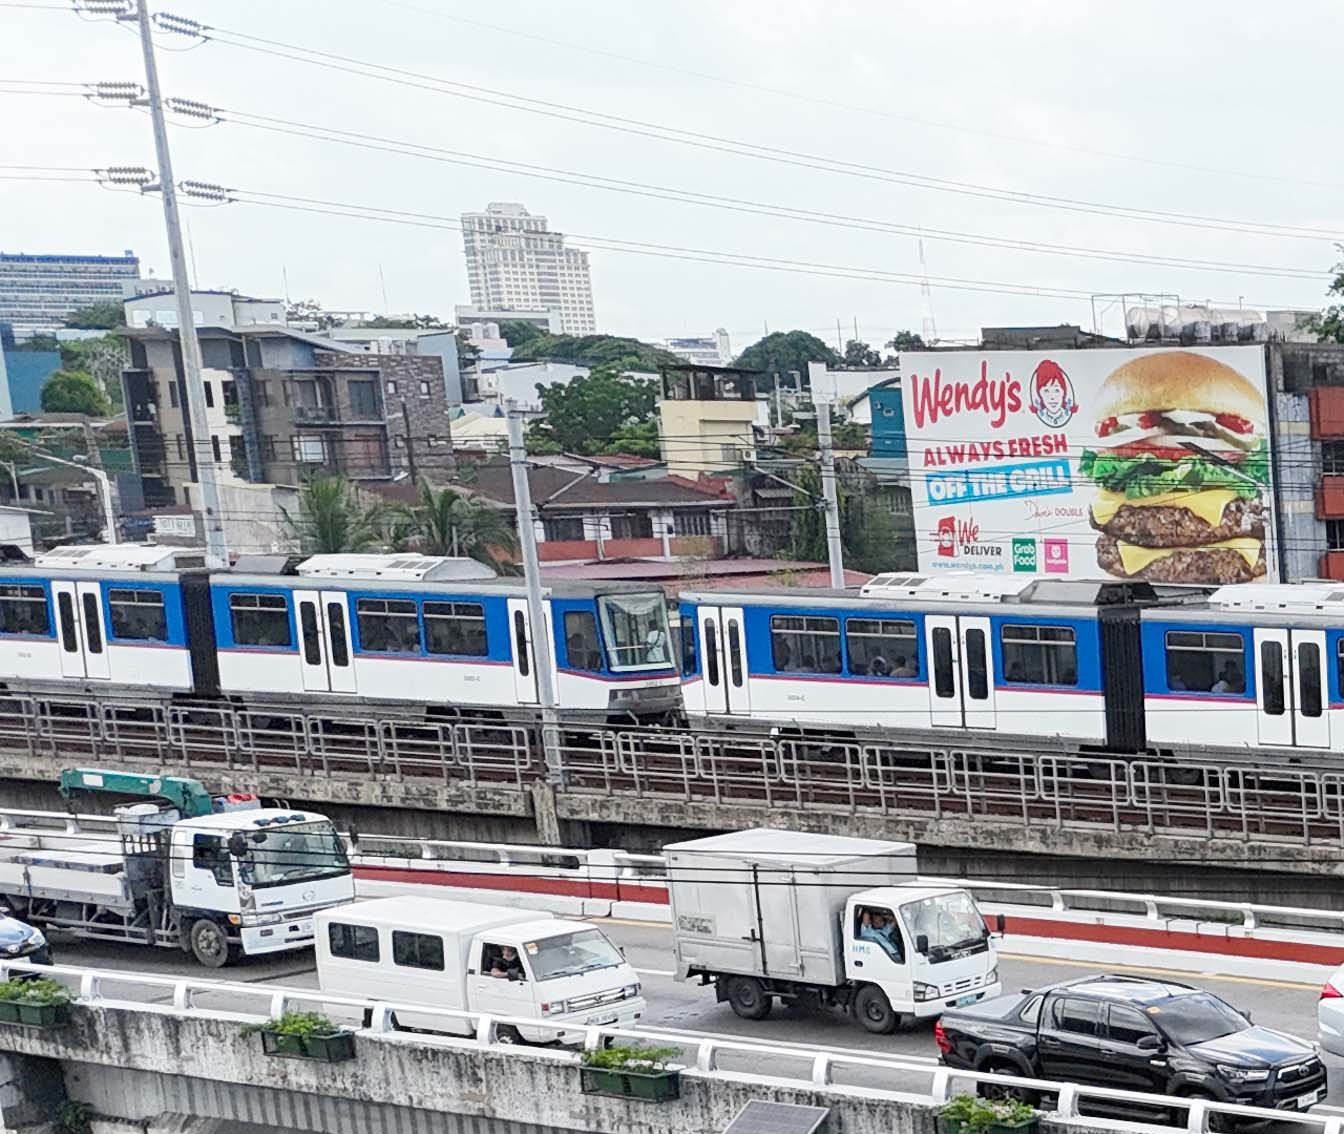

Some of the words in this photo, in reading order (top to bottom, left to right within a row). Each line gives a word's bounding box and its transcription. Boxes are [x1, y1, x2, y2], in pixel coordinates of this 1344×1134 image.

[911, 360, 1022, 428] Wendy's
[923, 440, 1005, 467] ALWAYS
[1007, 433, 1068, 458] FRESH
[929, 475, 968, 499] OFF
[969, 471, 1008, 496] THE
[1009, 465, 1071, 492] GRILL
[957, 517, 980, 546] We
[963, 545, 1002, 556] DELIVER
[1014, 543, 1035, 555] Grab
[1014, 554, 1036, 567] Food
